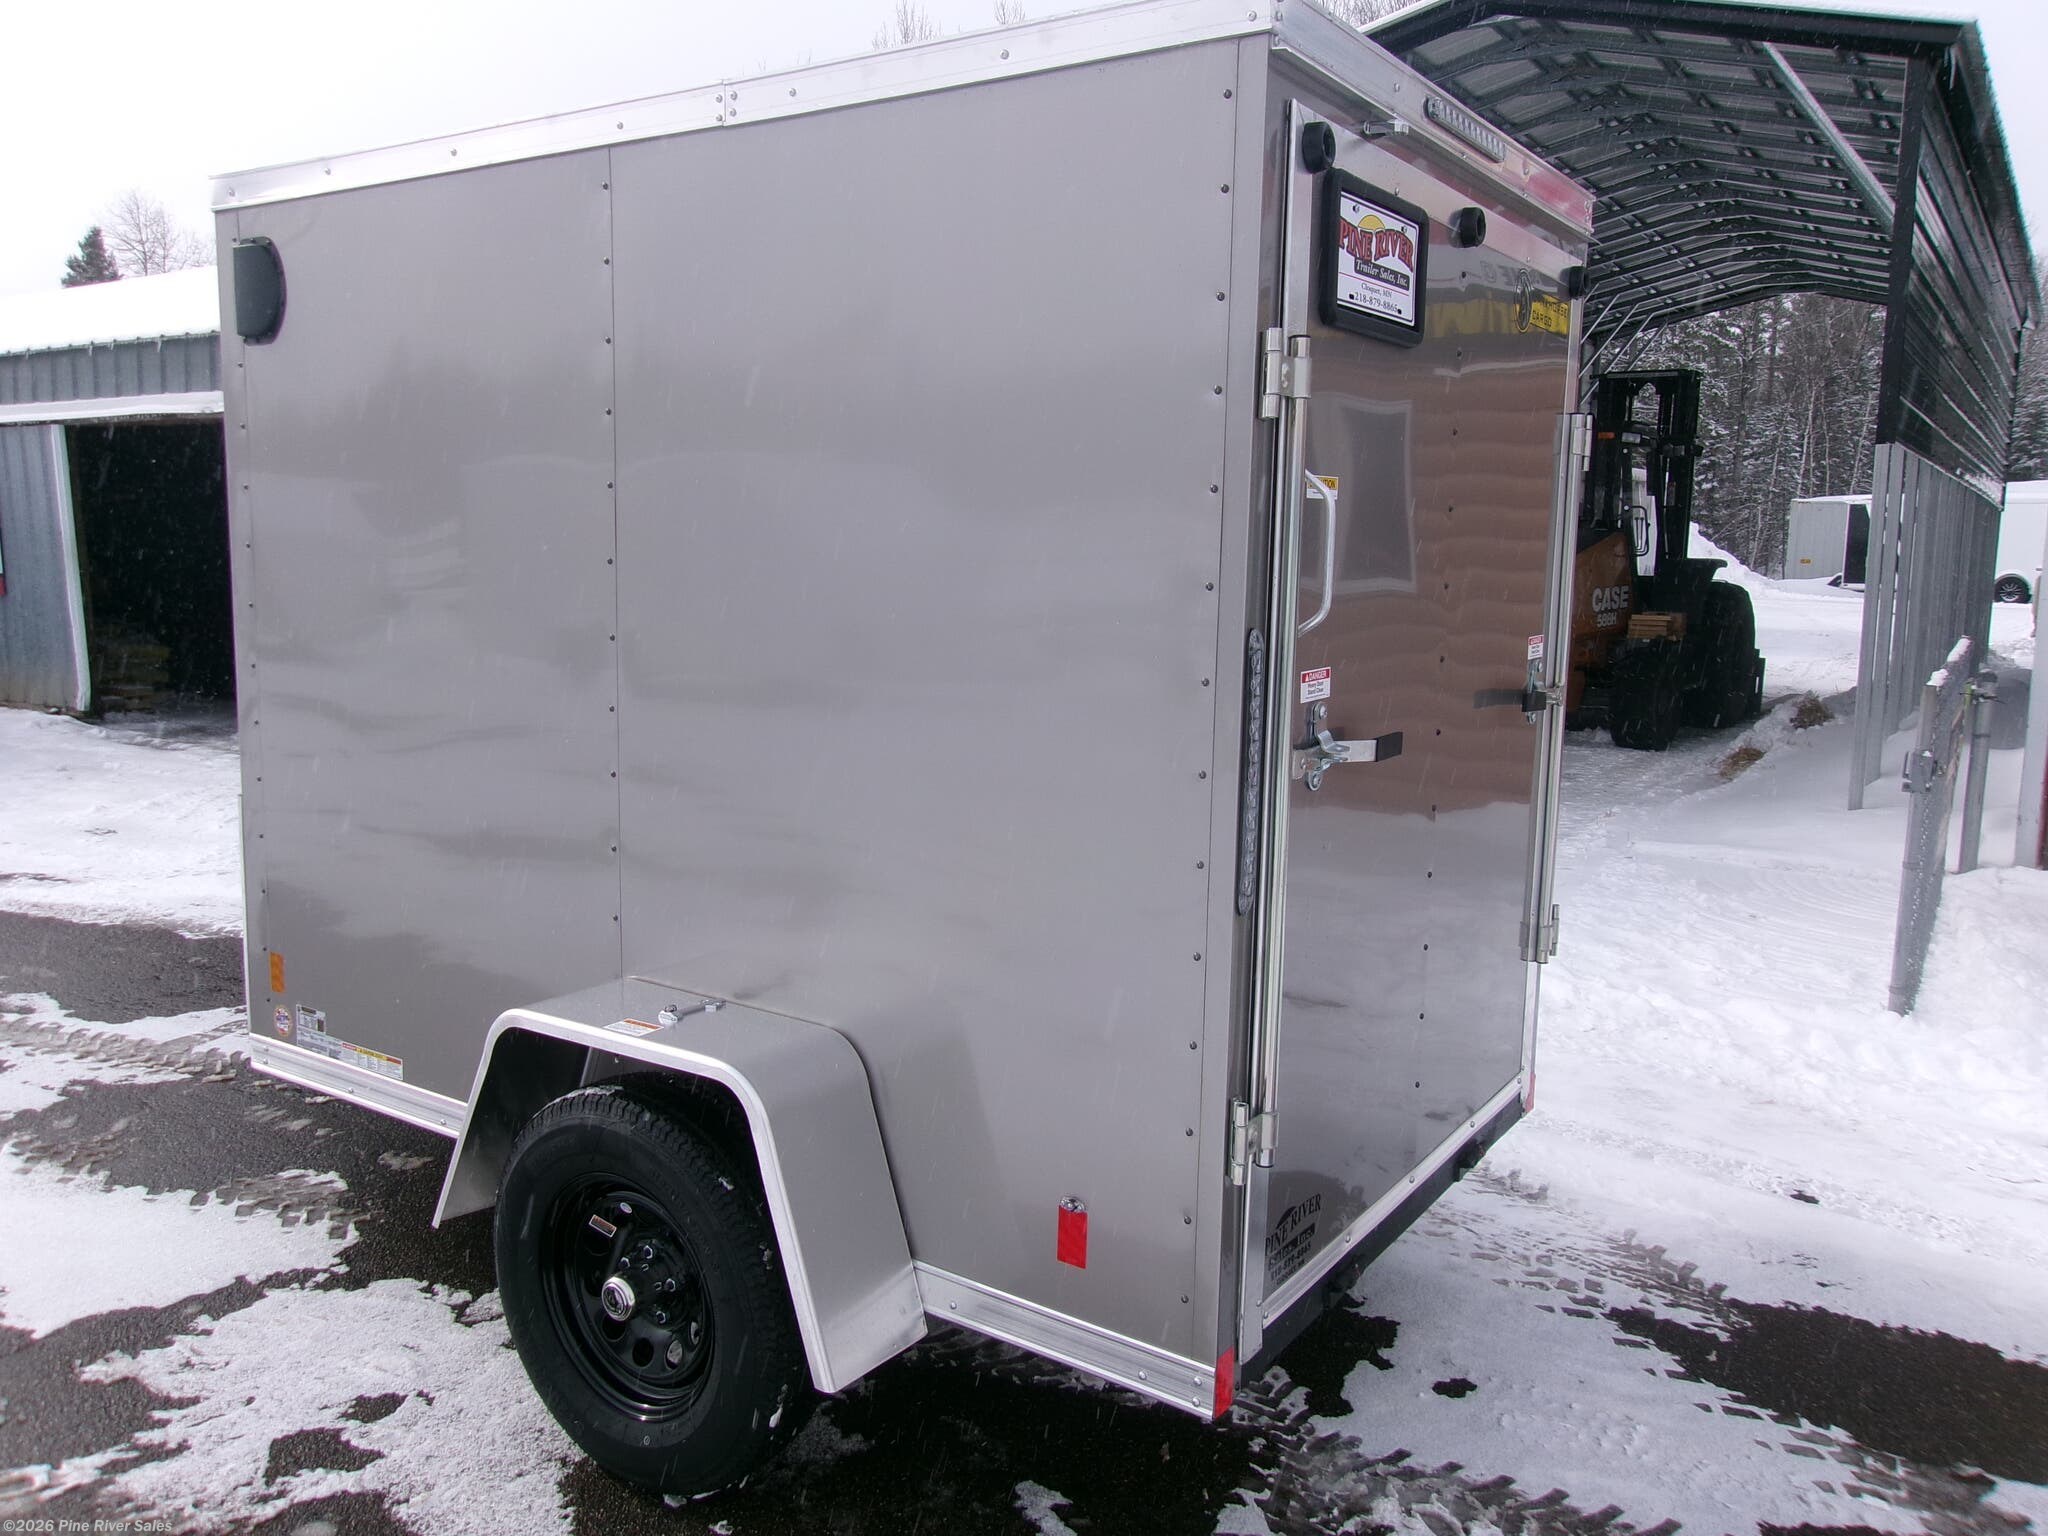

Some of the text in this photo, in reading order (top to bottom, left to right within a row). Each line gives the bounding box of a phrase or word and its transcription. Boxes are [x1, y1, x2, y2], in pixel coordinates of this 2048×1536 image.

[1338, 216, 1414, 273] PINE RIVER
[1356, 260, 1408, 287] Trailer Sales, Inc.
[1355, 292, 1398, 312] 218-879-8865
[1382, 288, 1392, 299] MN
[1532, 309, 1552, 328] CARGO
[1592, 585, 1630, 612] CASE
[1309, 670, 1328, 681] DANGER
[1265, 1193, 1321, 1256] PINE RIVER
